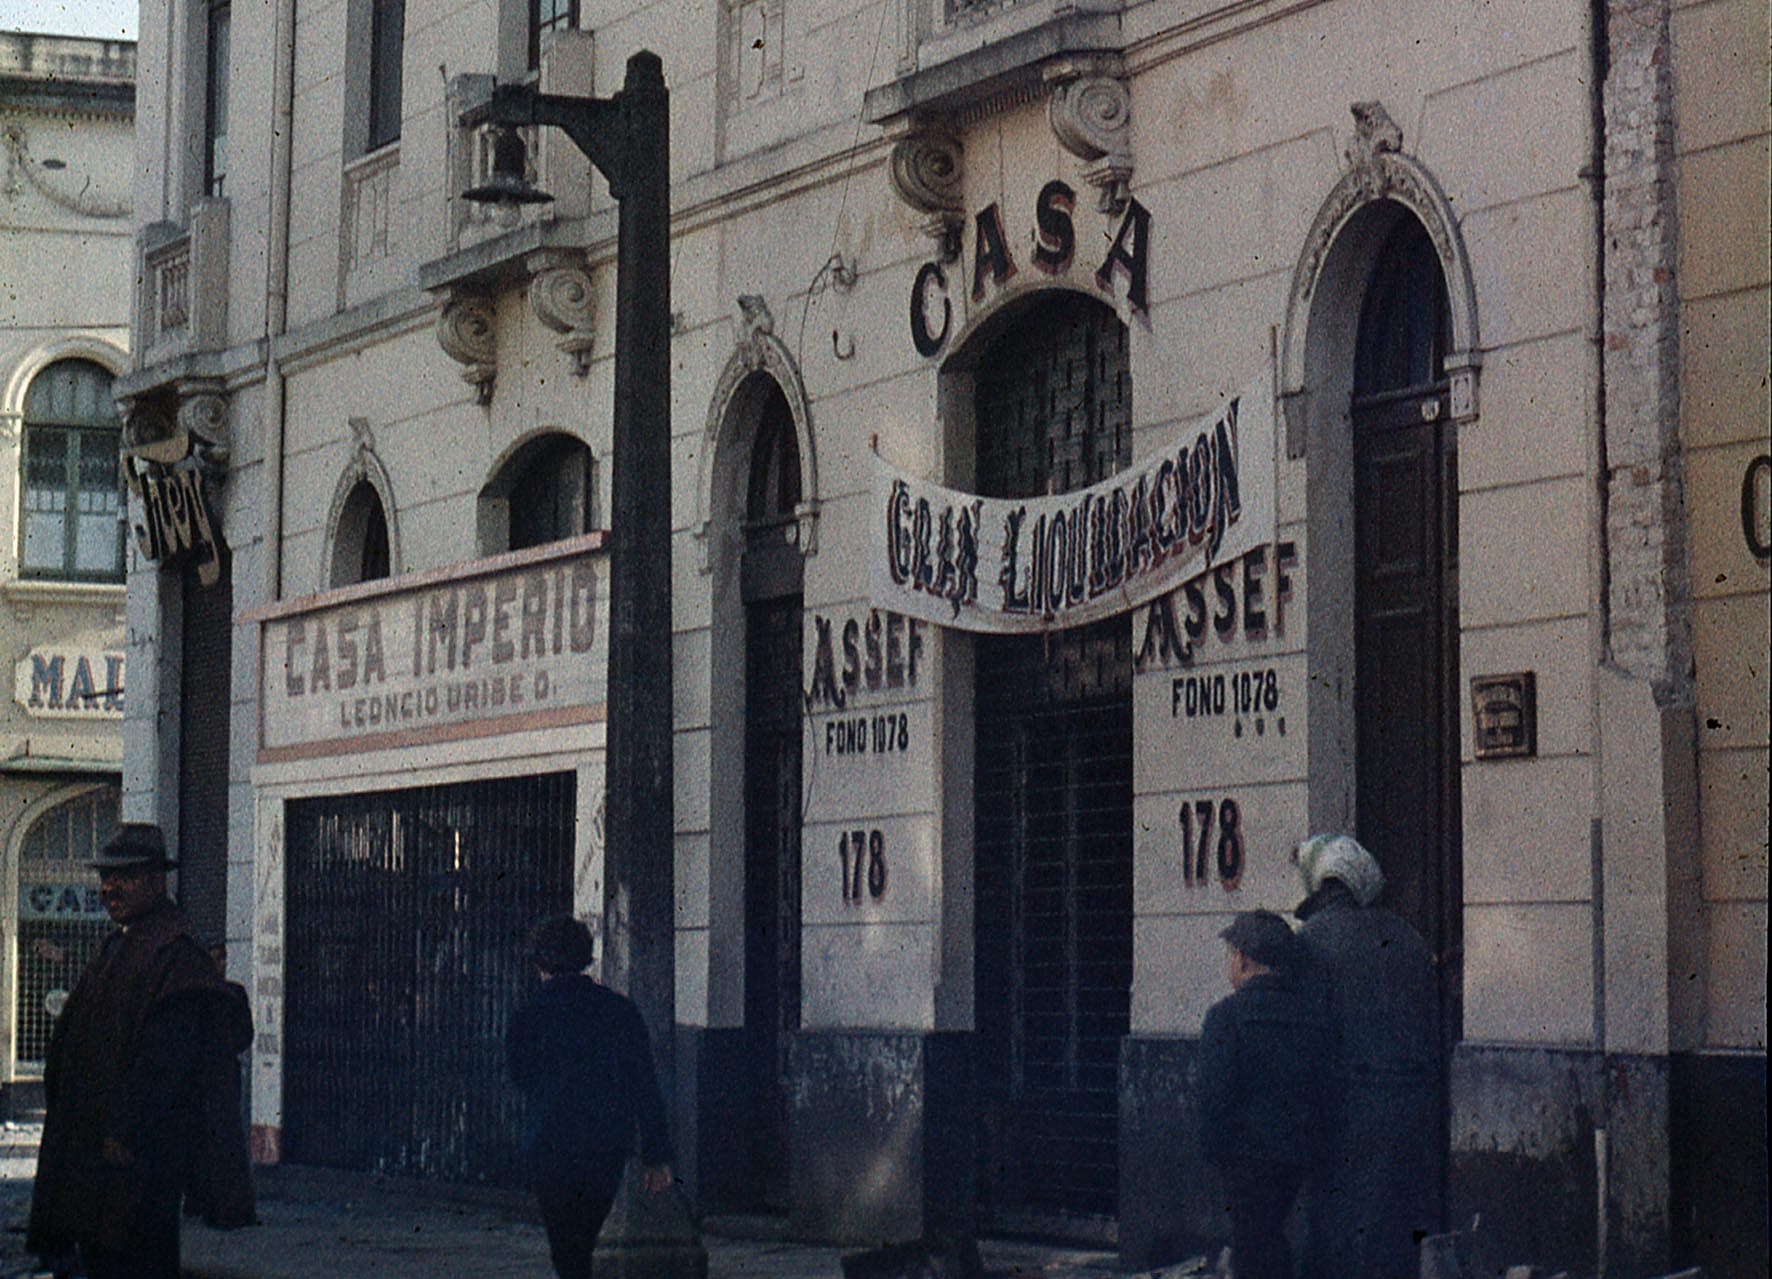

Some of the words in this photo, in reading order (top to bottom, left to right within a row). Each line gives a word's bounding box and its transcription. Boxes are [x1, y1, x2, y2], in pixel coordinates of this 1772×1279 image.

[910, 179, 1152, 359] CASA
[888, 478, 984, 619] GRAN
[999, 396, 1242, 619] LIQUIDACION
[285, 607, 385, 698] CASA
[413, 566, 599, 678] IMPERIO
[1133, 540, 1297, 669] ASSEF
[340, 685, 440, 729] LEONCIO
[447, 671, 525, 713] URIBE
[806, 607, 927, 708] ASSEF
[1171, 673, 1225, 718] FONO
[1232, 667, 1279, 713] 1078
[826, 716, 867, 756] FONO
[872, 711, 909, 754] 1078
[839, 828, 888, 904] 178
[1179, 797, 1245, 893] 178
